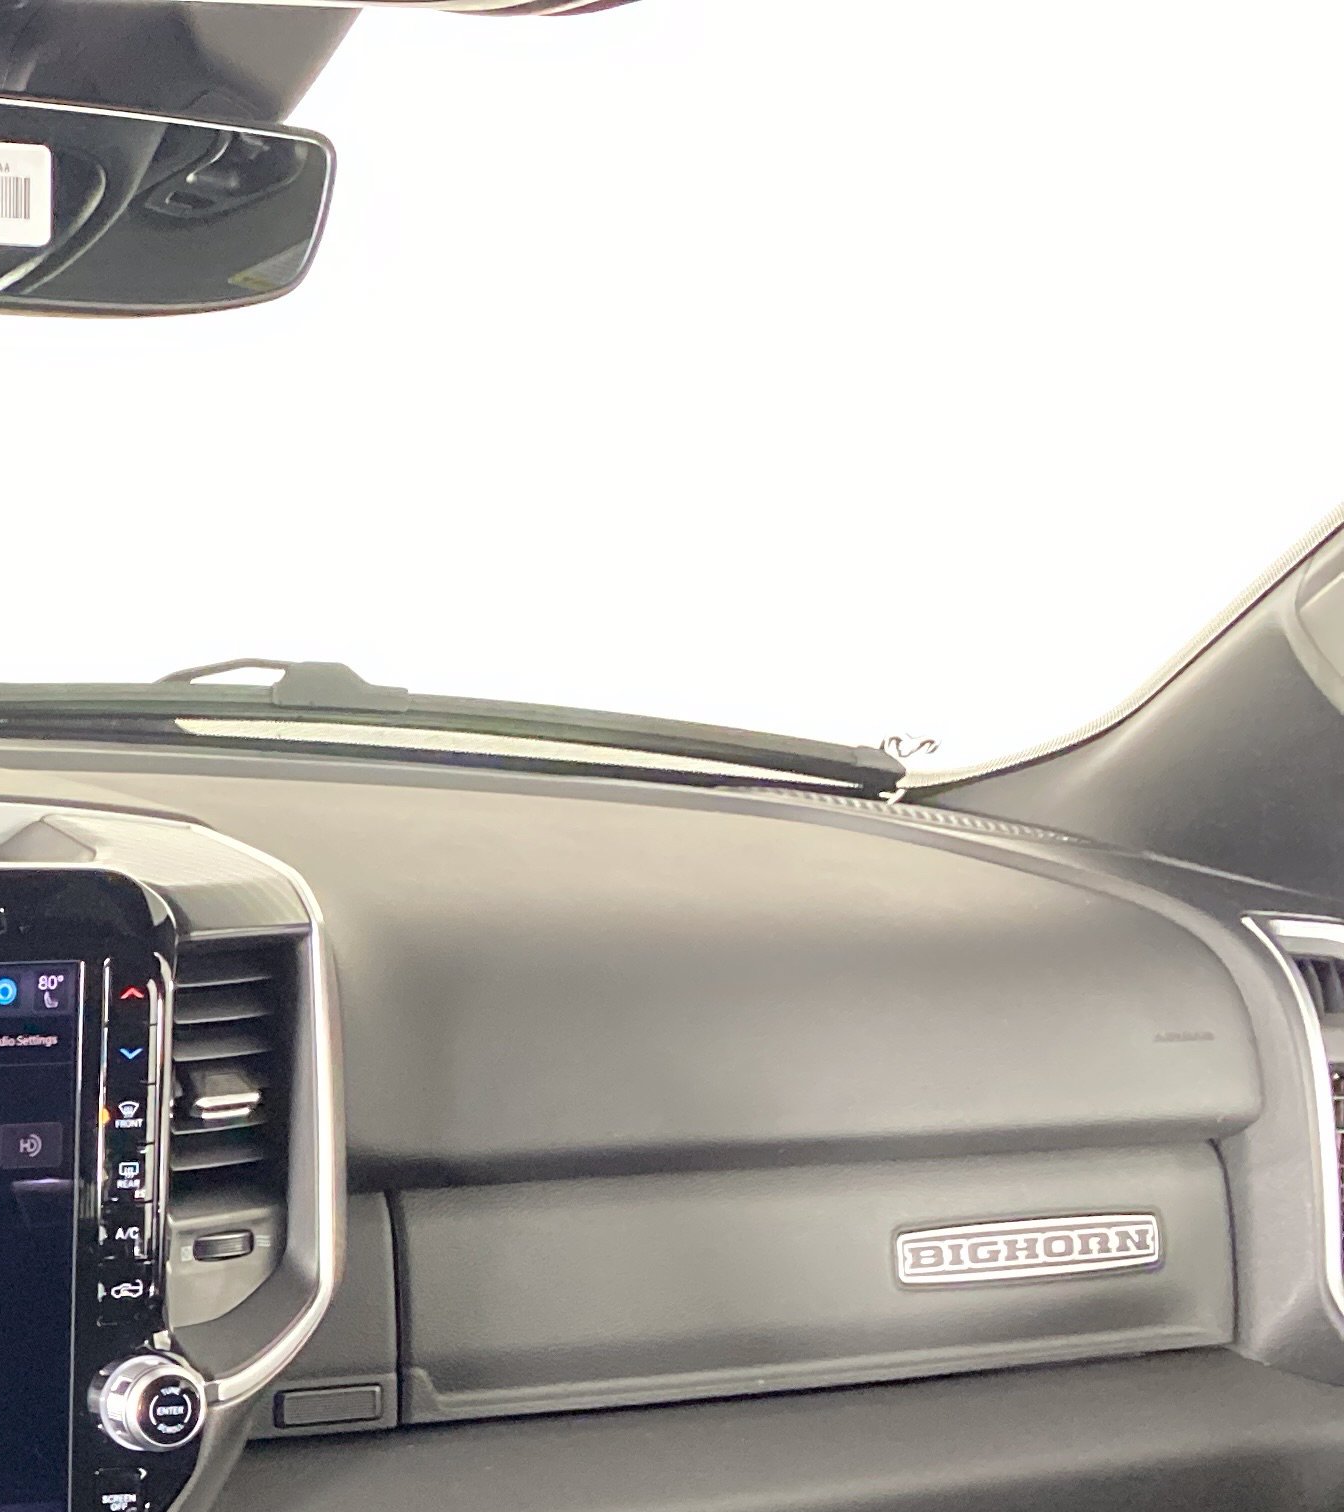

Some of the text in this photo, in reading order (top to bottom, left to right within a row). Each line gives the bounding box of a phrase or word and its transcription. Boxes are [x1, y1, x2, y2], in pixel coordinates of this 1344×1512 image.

[37, 974, 64, 991] 80°
[17, 1033, 59, 1048] Settings
[115, 1119, 143, 1128] FRONT
[115, 1226, 139, 1240] A/C
[905, 1228, 1154, 1270] BIGHORN
[157, 1406, 184, 1416] ENTER
